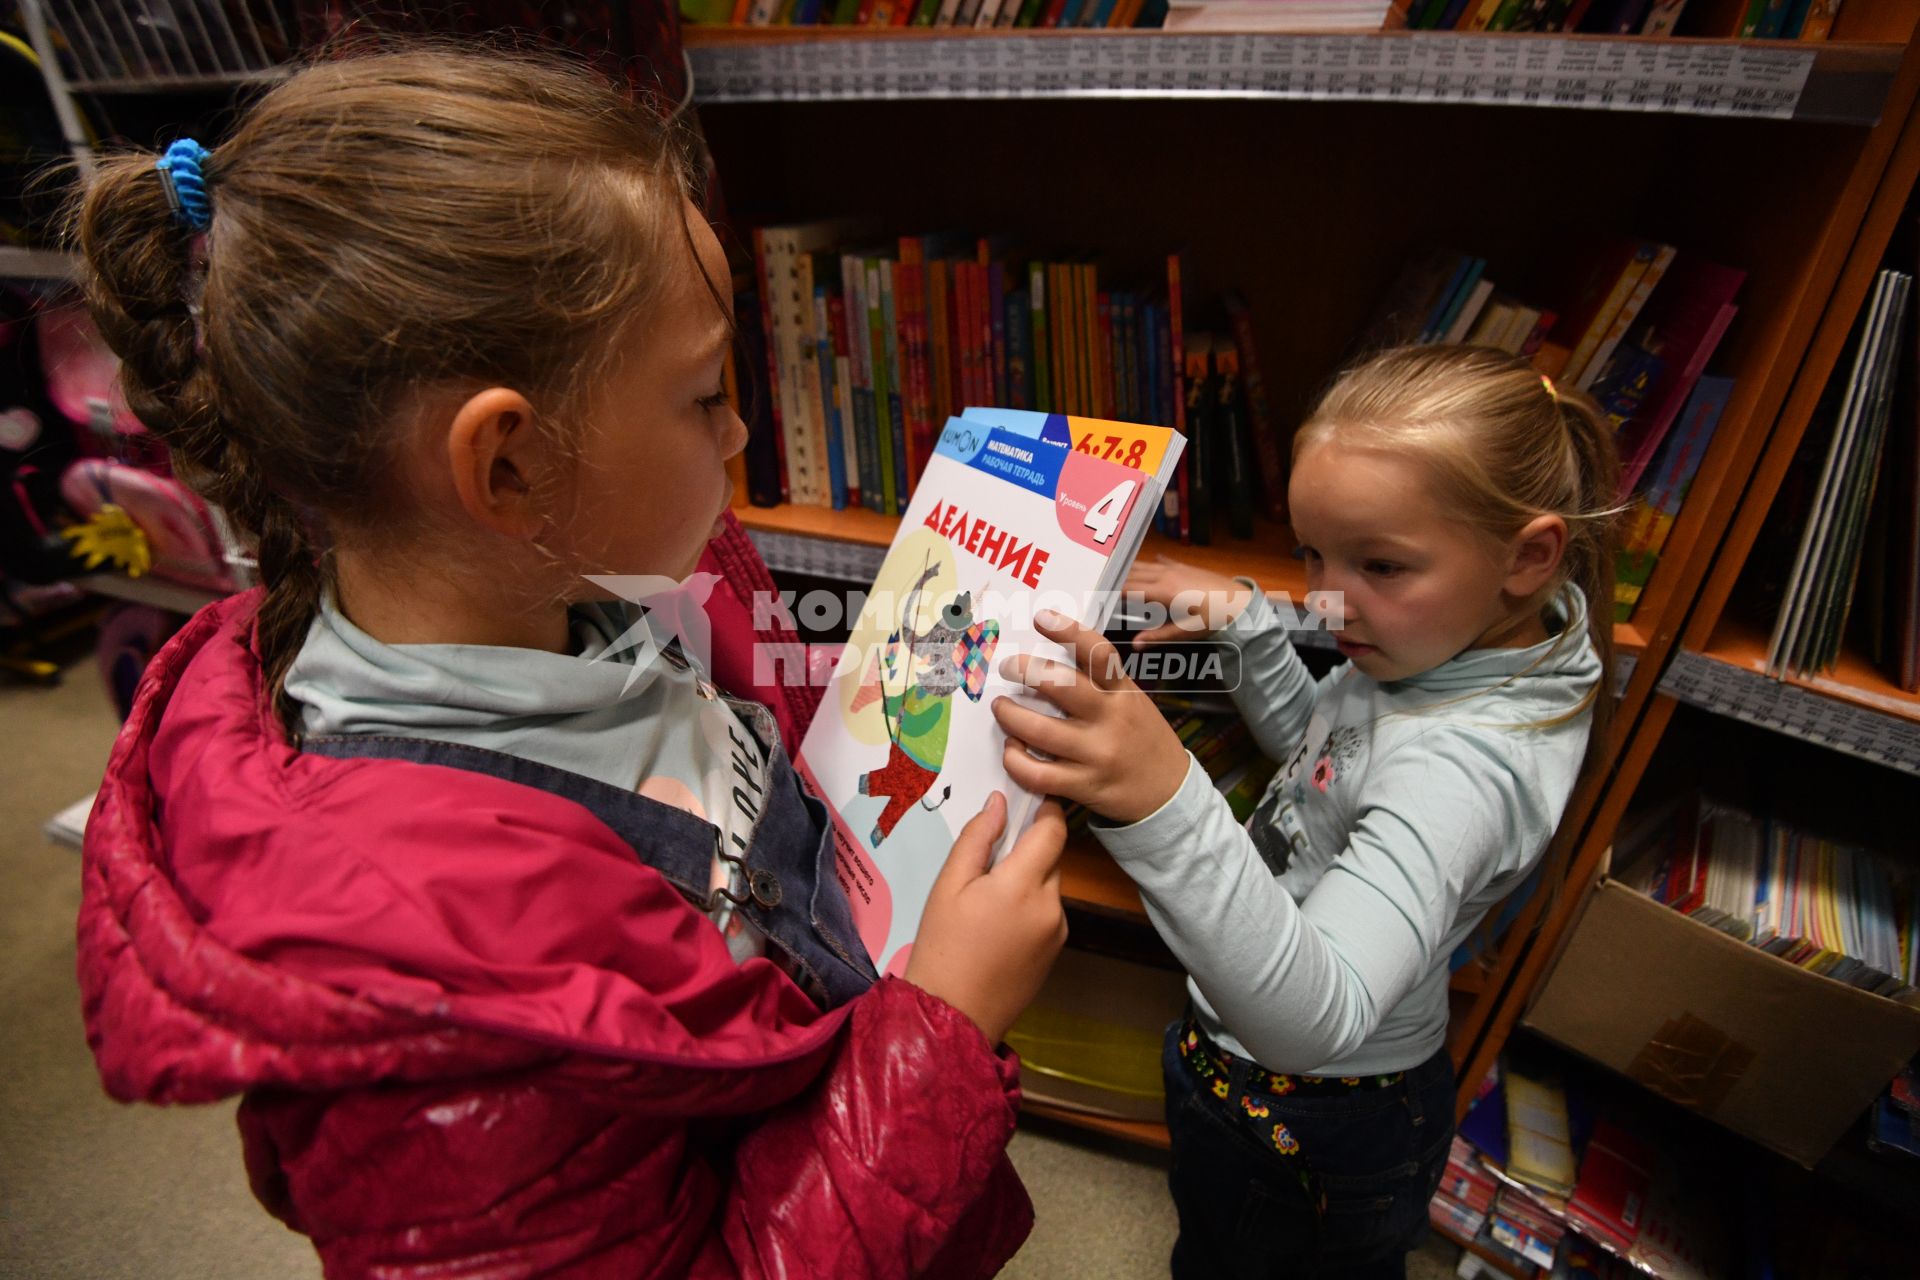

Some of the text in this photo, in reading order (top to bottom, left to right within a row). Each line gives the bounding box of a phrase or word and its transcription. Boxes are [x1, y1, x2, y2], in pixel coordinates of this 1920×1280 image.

[943, 430, 980, 453] KUMON
[987, 439, 1034, 464] МАТЕМАТИКА
[981, 453, 1046, 486] РАБОЧАЯ ТЕТРАДЬ
[1059, 491, 1087, 513] Уровень
[1084, 480, 1136, 544] 4
[923, 497, 1050, 591] ДЕЛЕНИЕ
